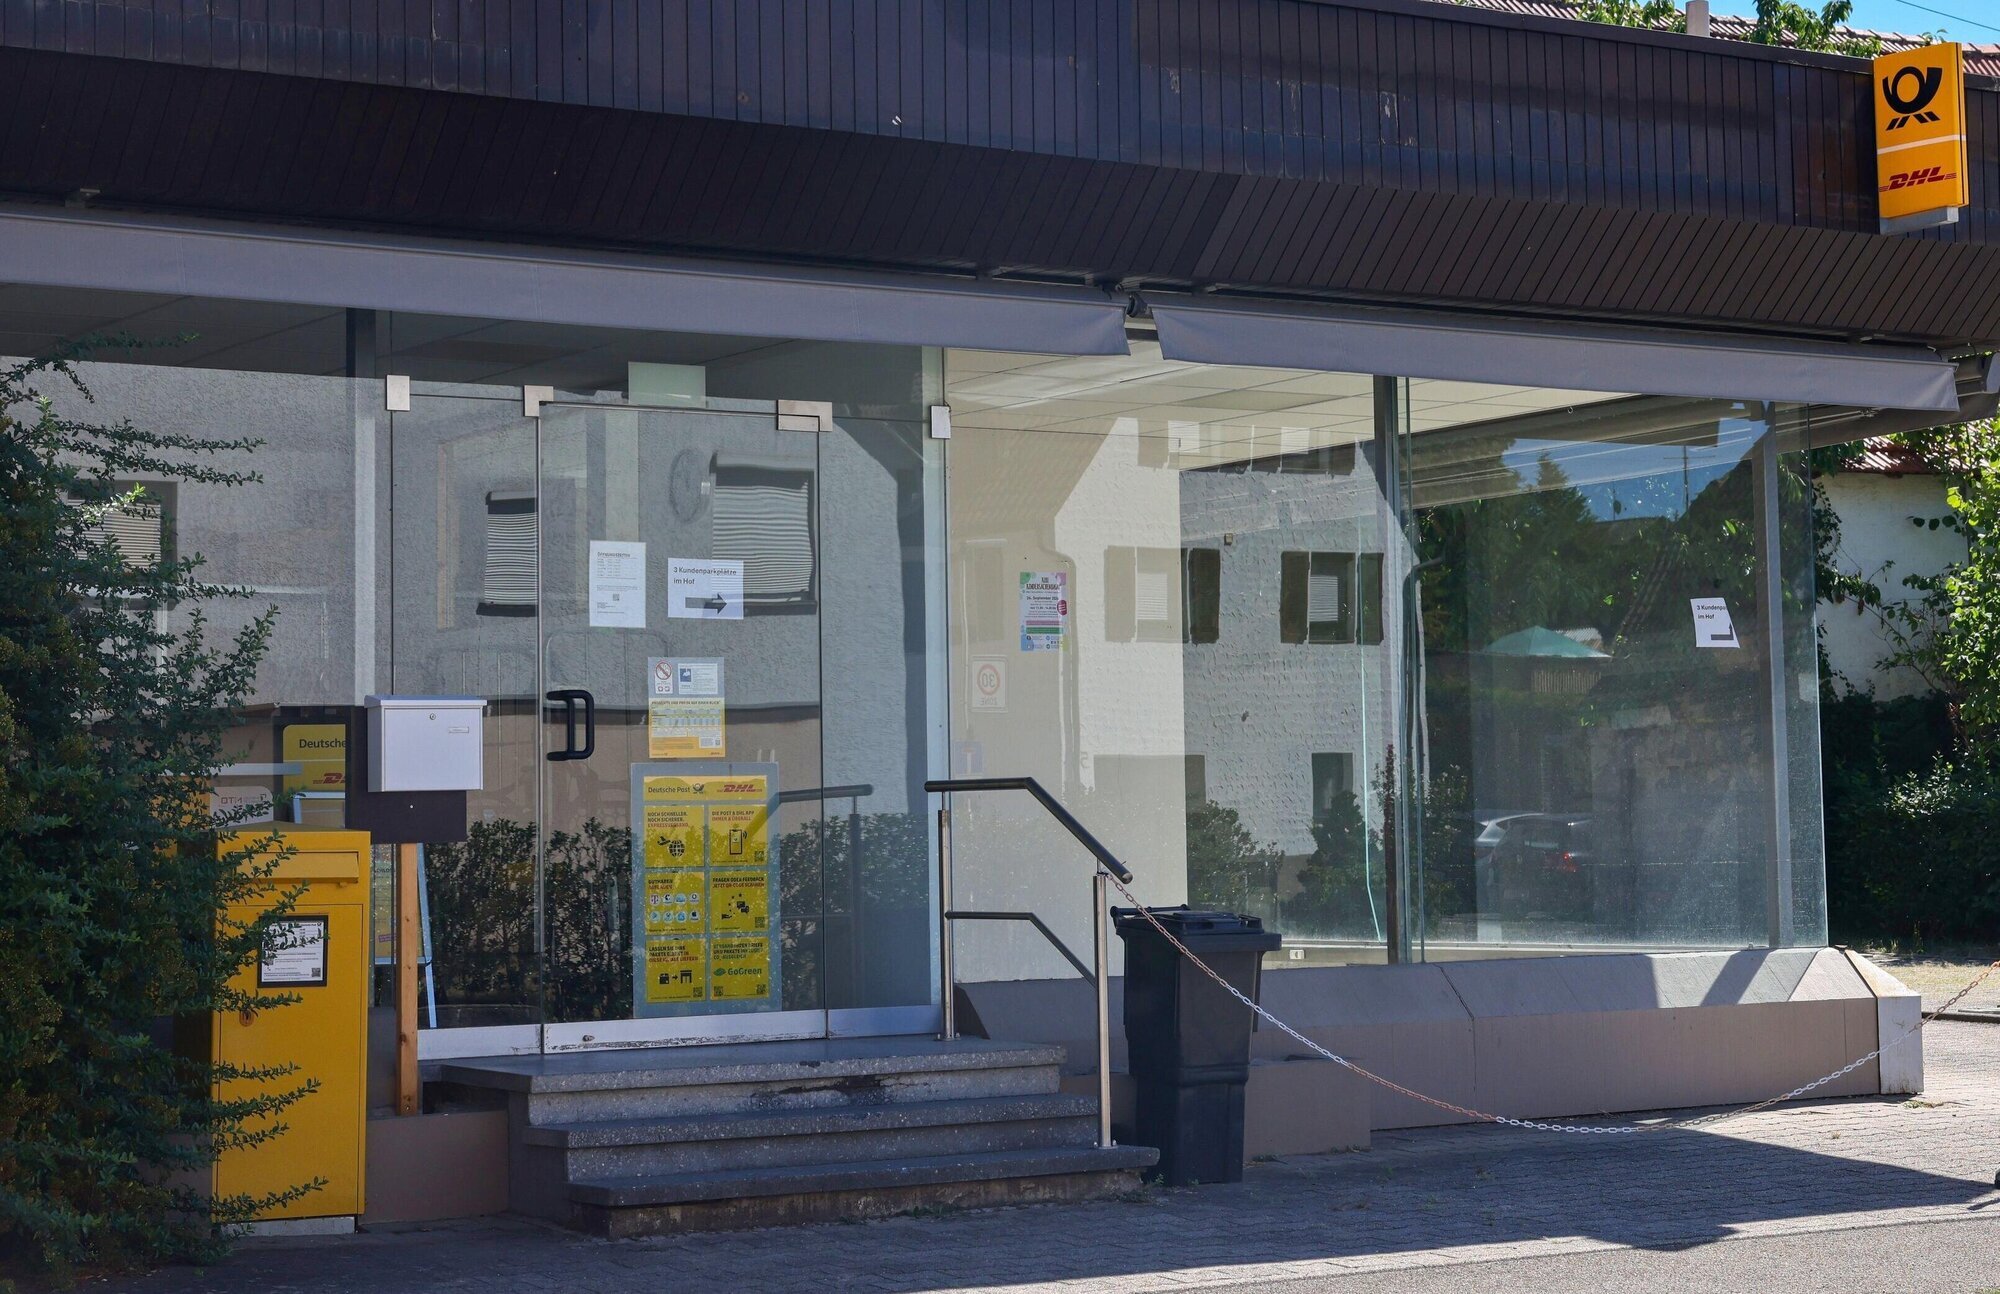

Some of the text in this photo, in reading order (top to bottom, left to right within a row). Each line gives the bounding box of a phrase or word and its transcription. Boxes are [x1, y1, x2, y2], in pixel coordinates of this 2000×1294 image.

[1889, 166, 1946, 191] DHL
[679, 566, 737, 576] Kundenparkplätze
[723, 784, 756, 793] DHL
[727, 967, 762, 976] GoGreen
